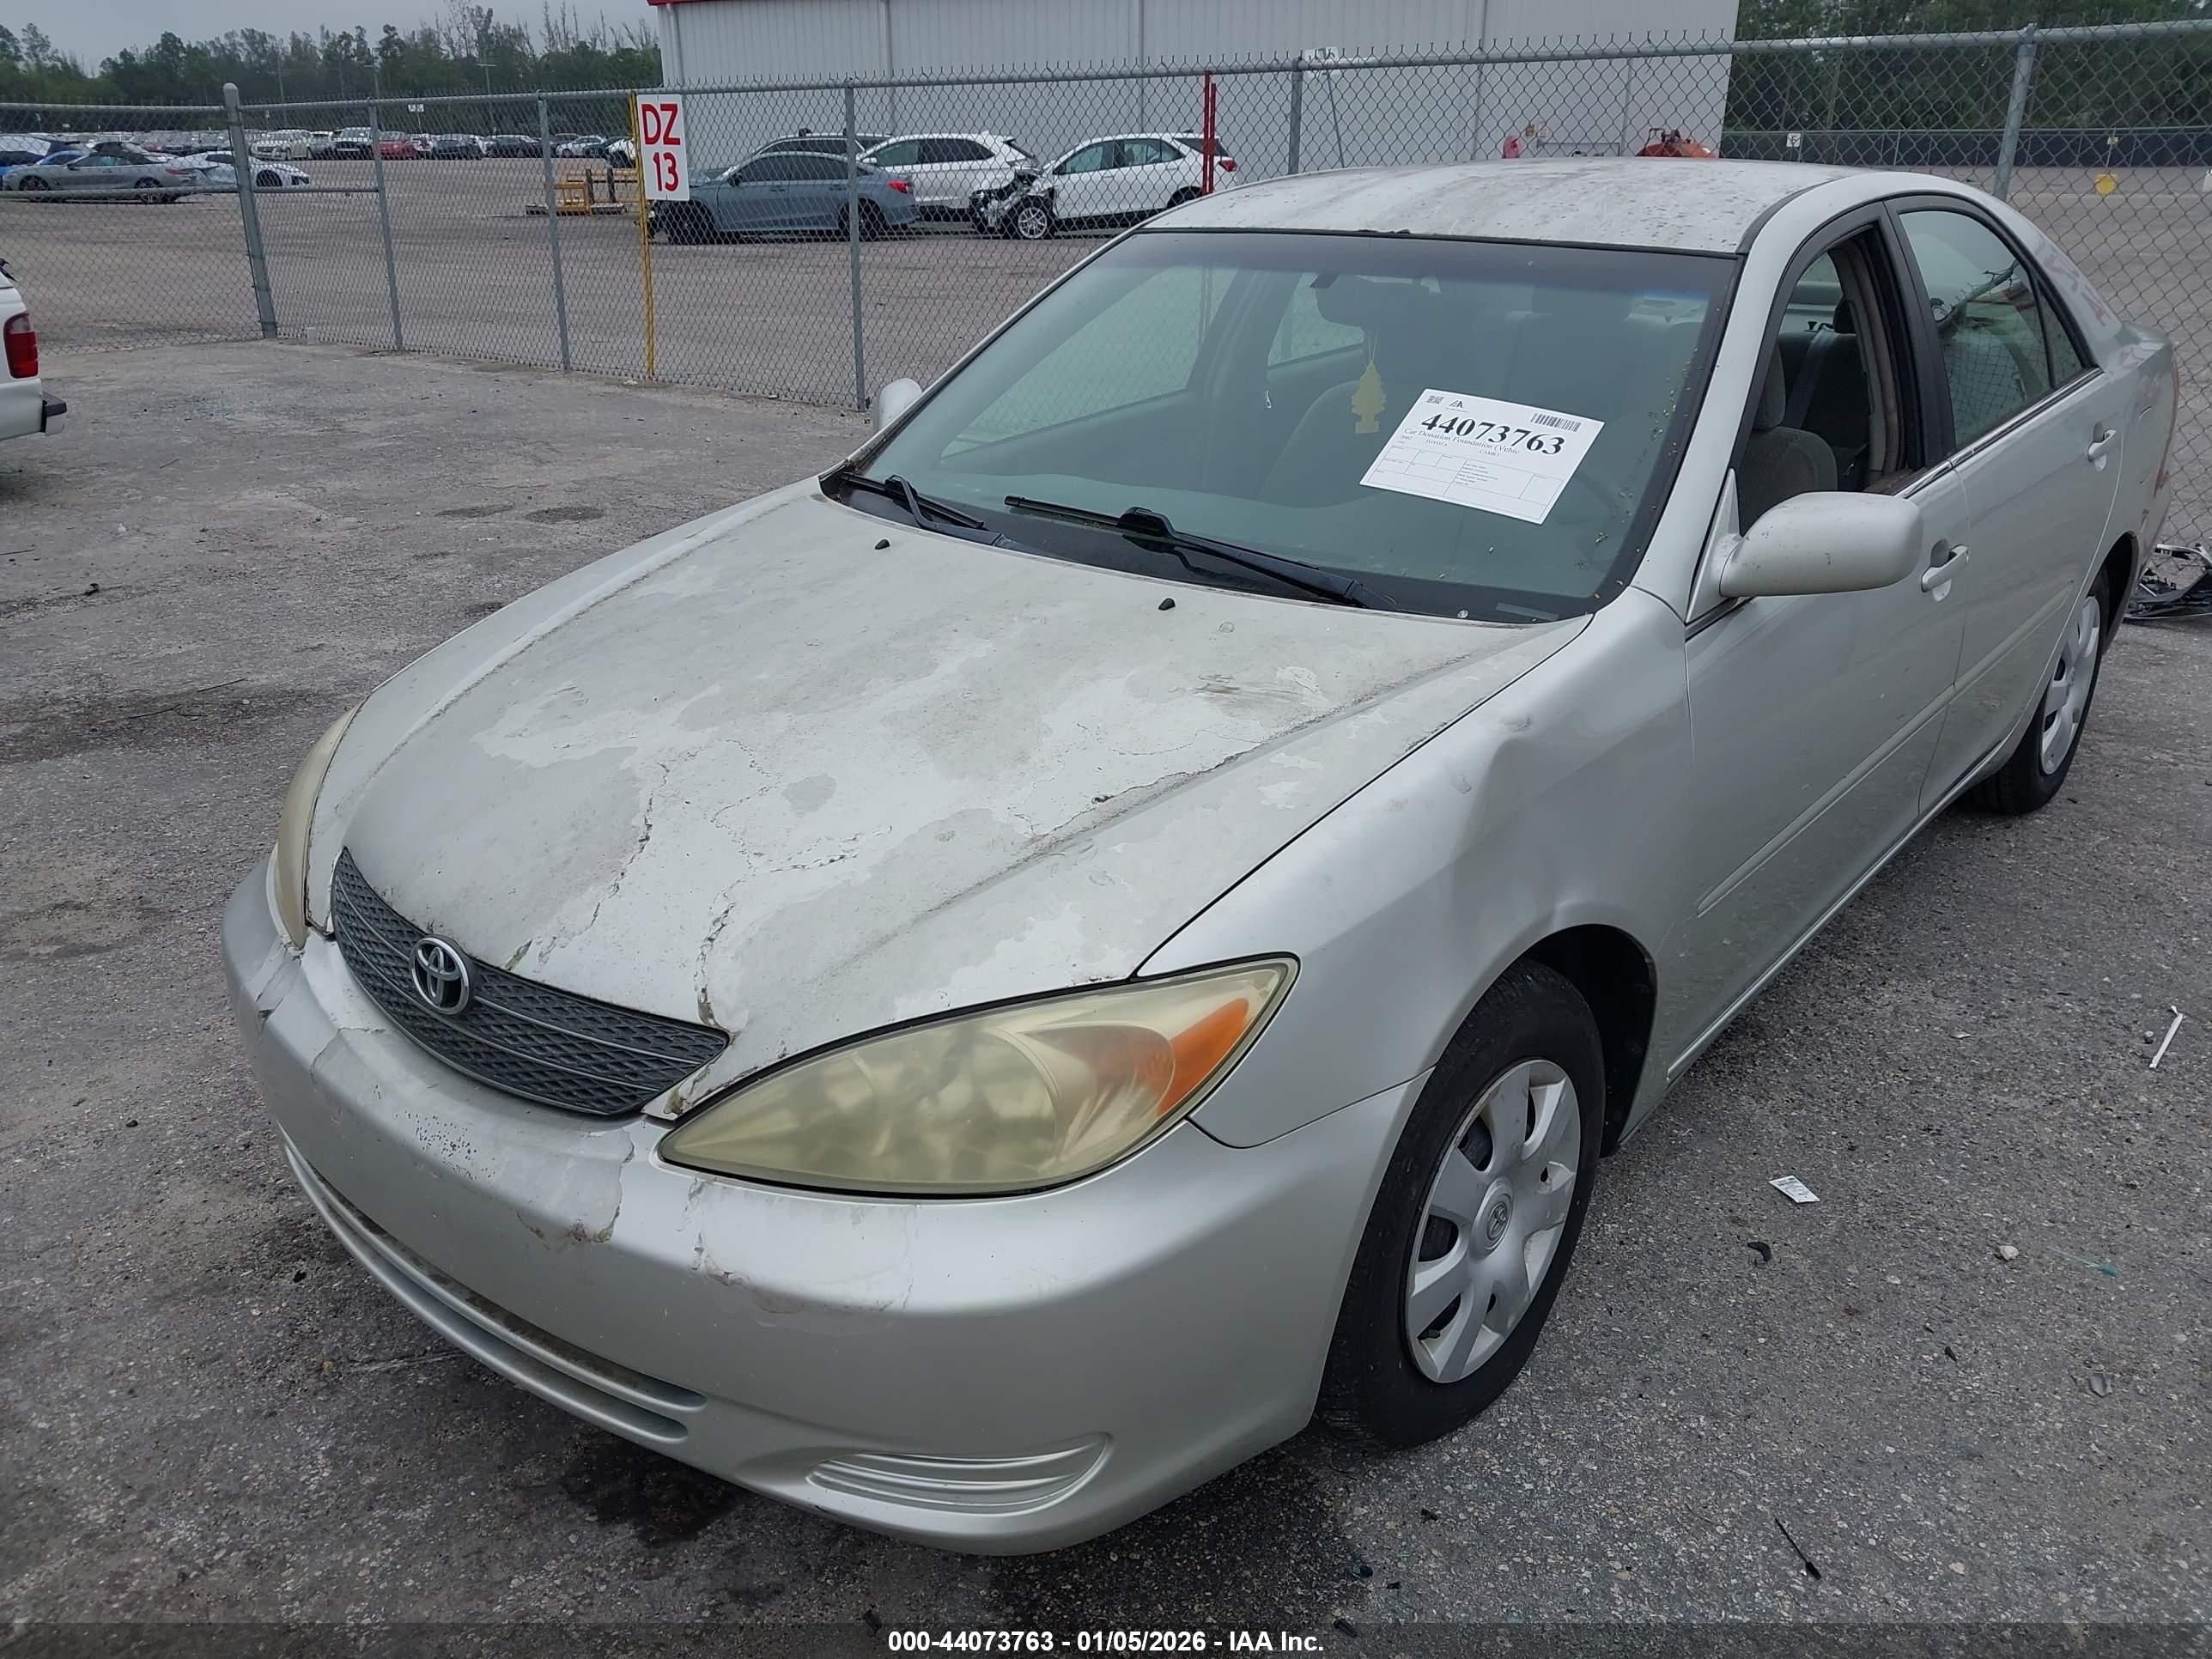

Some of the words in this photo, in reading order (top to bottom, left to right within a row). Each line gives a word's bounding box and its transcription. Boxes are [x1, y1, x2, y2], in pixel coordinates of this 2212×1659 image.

[641, 103, 681, 146] DZ
[653, 151, 679, 191] 13
[1418, 430, 1451, 441] Donation
[1452, 436, 1493, 448] Foundation
[1421, 413, 1565, 455] 44073763
